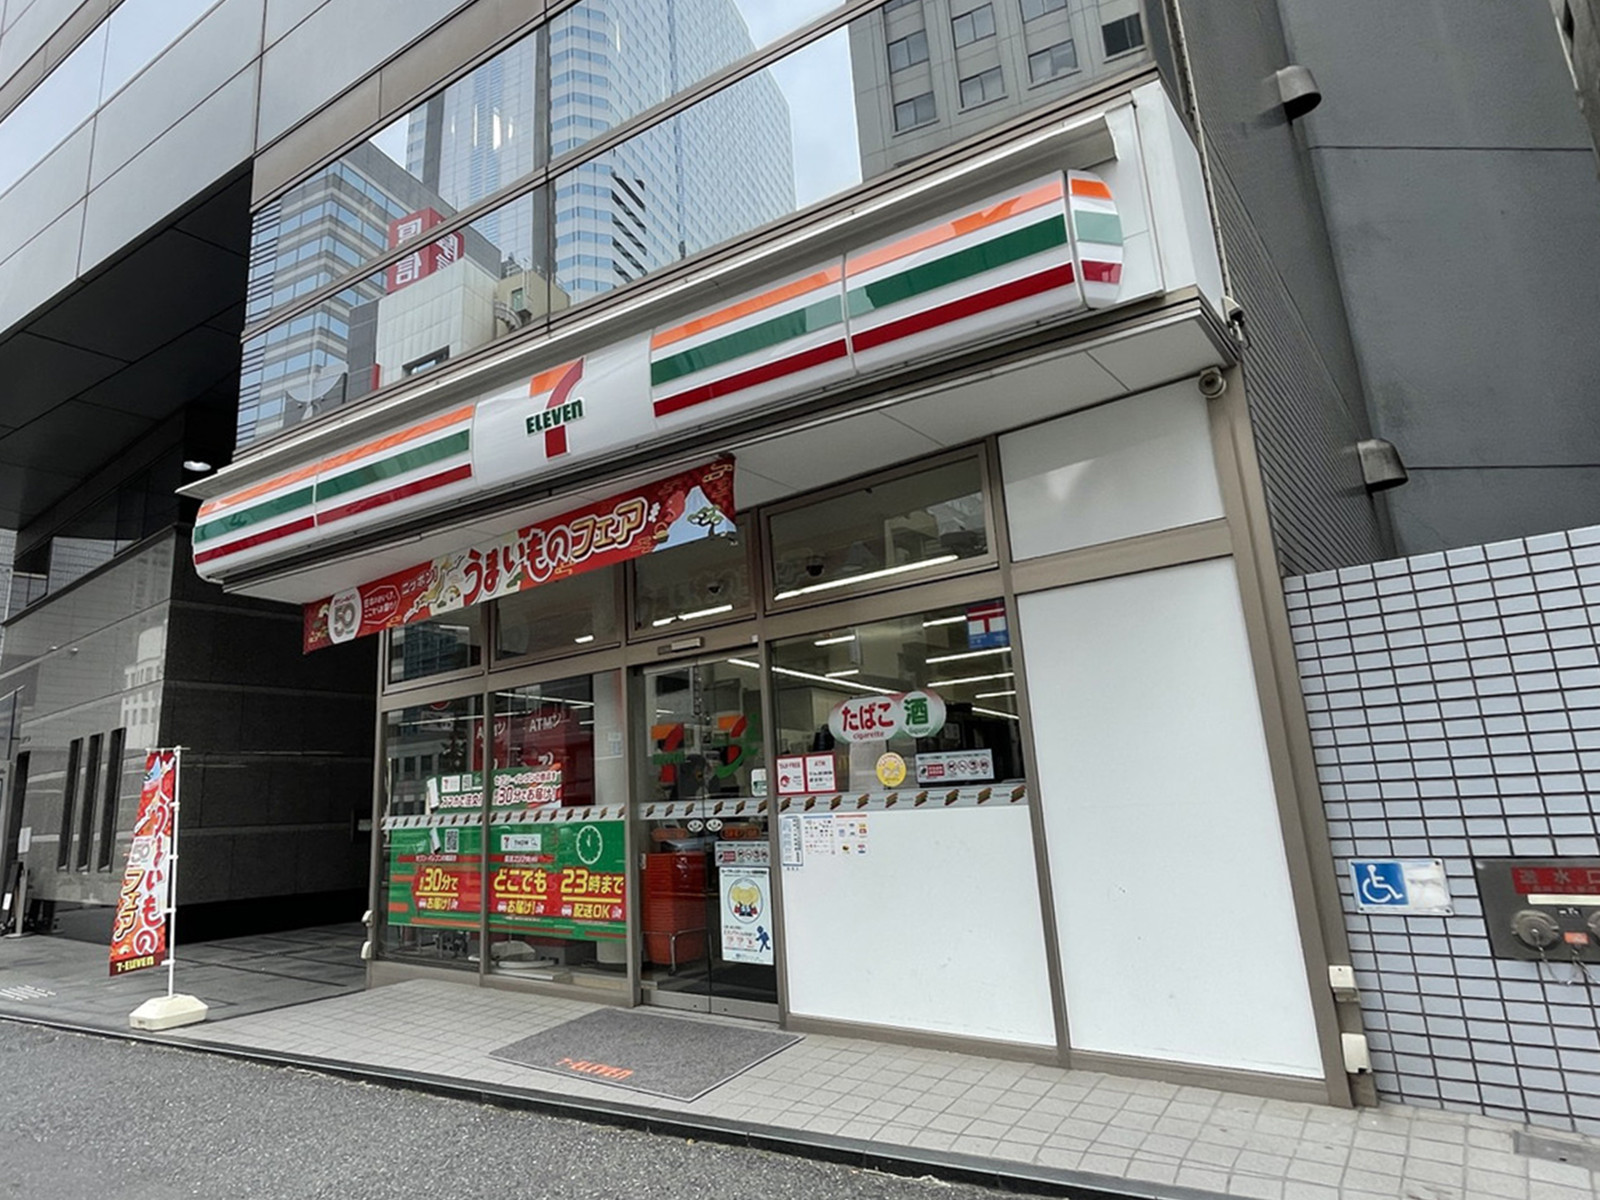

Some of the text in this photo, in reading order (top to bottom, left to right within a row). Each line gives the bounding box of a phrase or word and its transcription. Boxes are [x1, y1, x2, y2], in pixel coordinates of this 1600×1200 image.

[463, 500, 646, 606] うまいものフェア
[842, 703, 894, 732] たばこ
[903, 698, 929, 725] 酒
[853, 731, 884, 740] cigarette
[493, 868, 547, 893] どこでも
[560, 869, 624, 894] 23時まで
[114, 869, 145, 939] フェア
[573, 902, 611, 919] 配送OK
